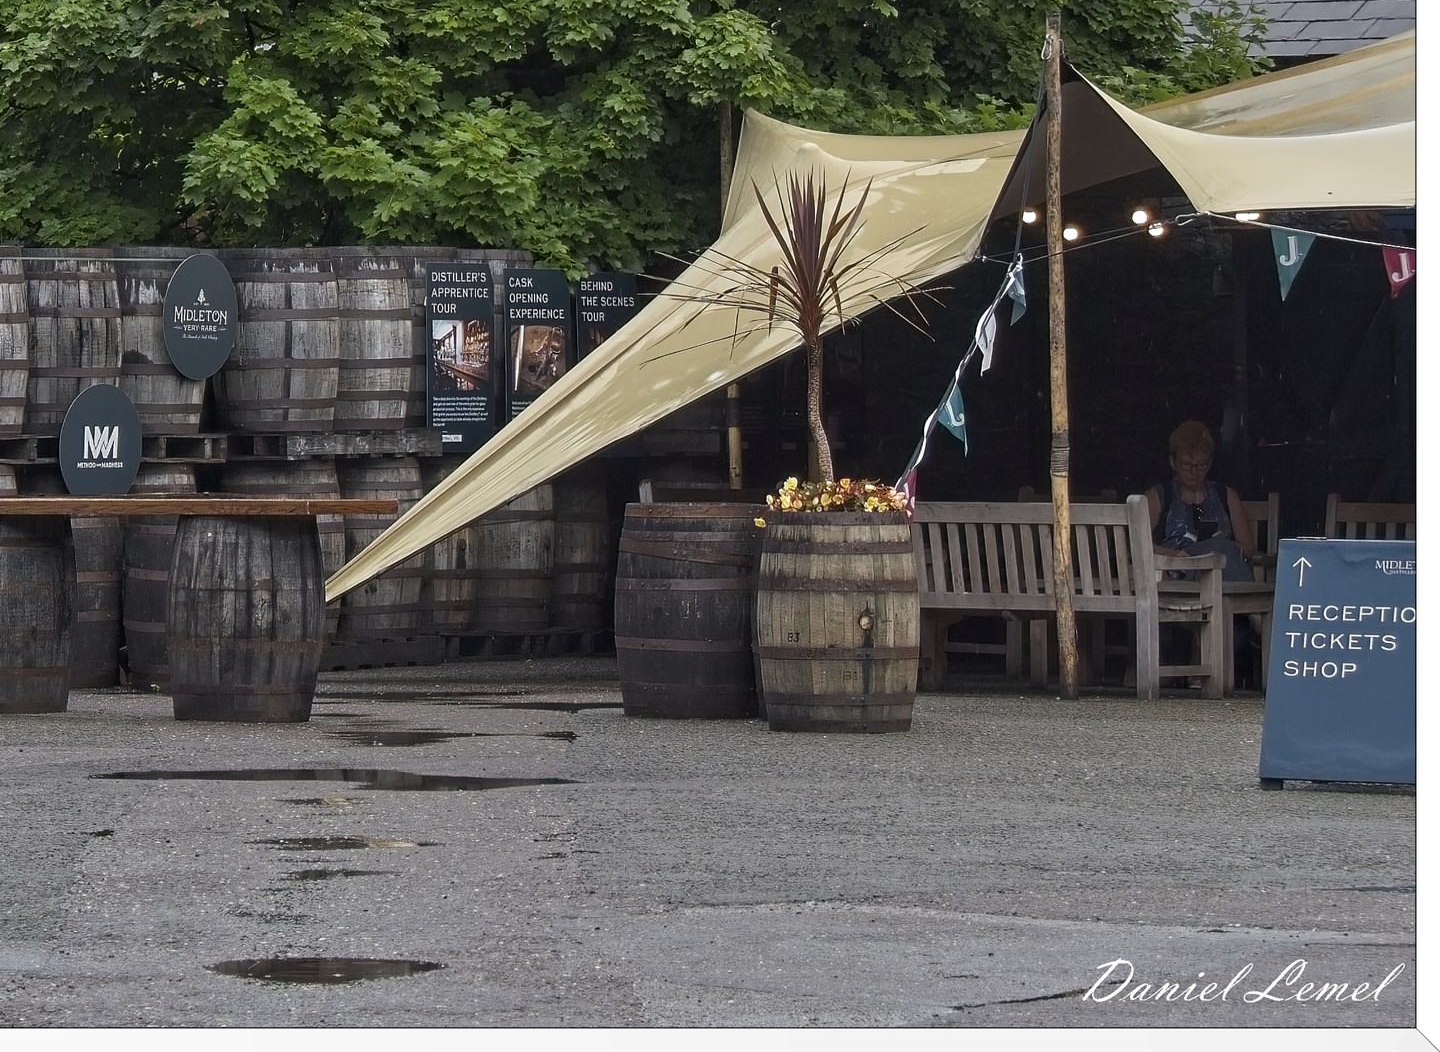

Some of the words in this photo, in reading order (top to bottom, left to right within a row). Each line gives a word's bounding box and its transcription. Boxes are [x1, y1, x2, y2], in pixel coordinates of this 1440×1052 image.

[431, 271, 487, 283] DISTILLER'S
[508, 277, 534, 288] CASK
[580, 281, 614, 292] BEHIND
[431, 287, 489, 298] APPRENTICE
[509, 293, 549, 304] OPENING
[580, 296, 599, 306] THE
[600, 296, 635, 307] SCENES
[431, 303, 457, 314] TOUR
[510, 308, 565, 319] EXPERIENCE
[173, 305, 228, 325] MIDLETON
[580, 311, 605, 322] TOUR
[1285, 631, 1397, 651] TICKETS
[1283, 660, 1358, 679] SHOP
